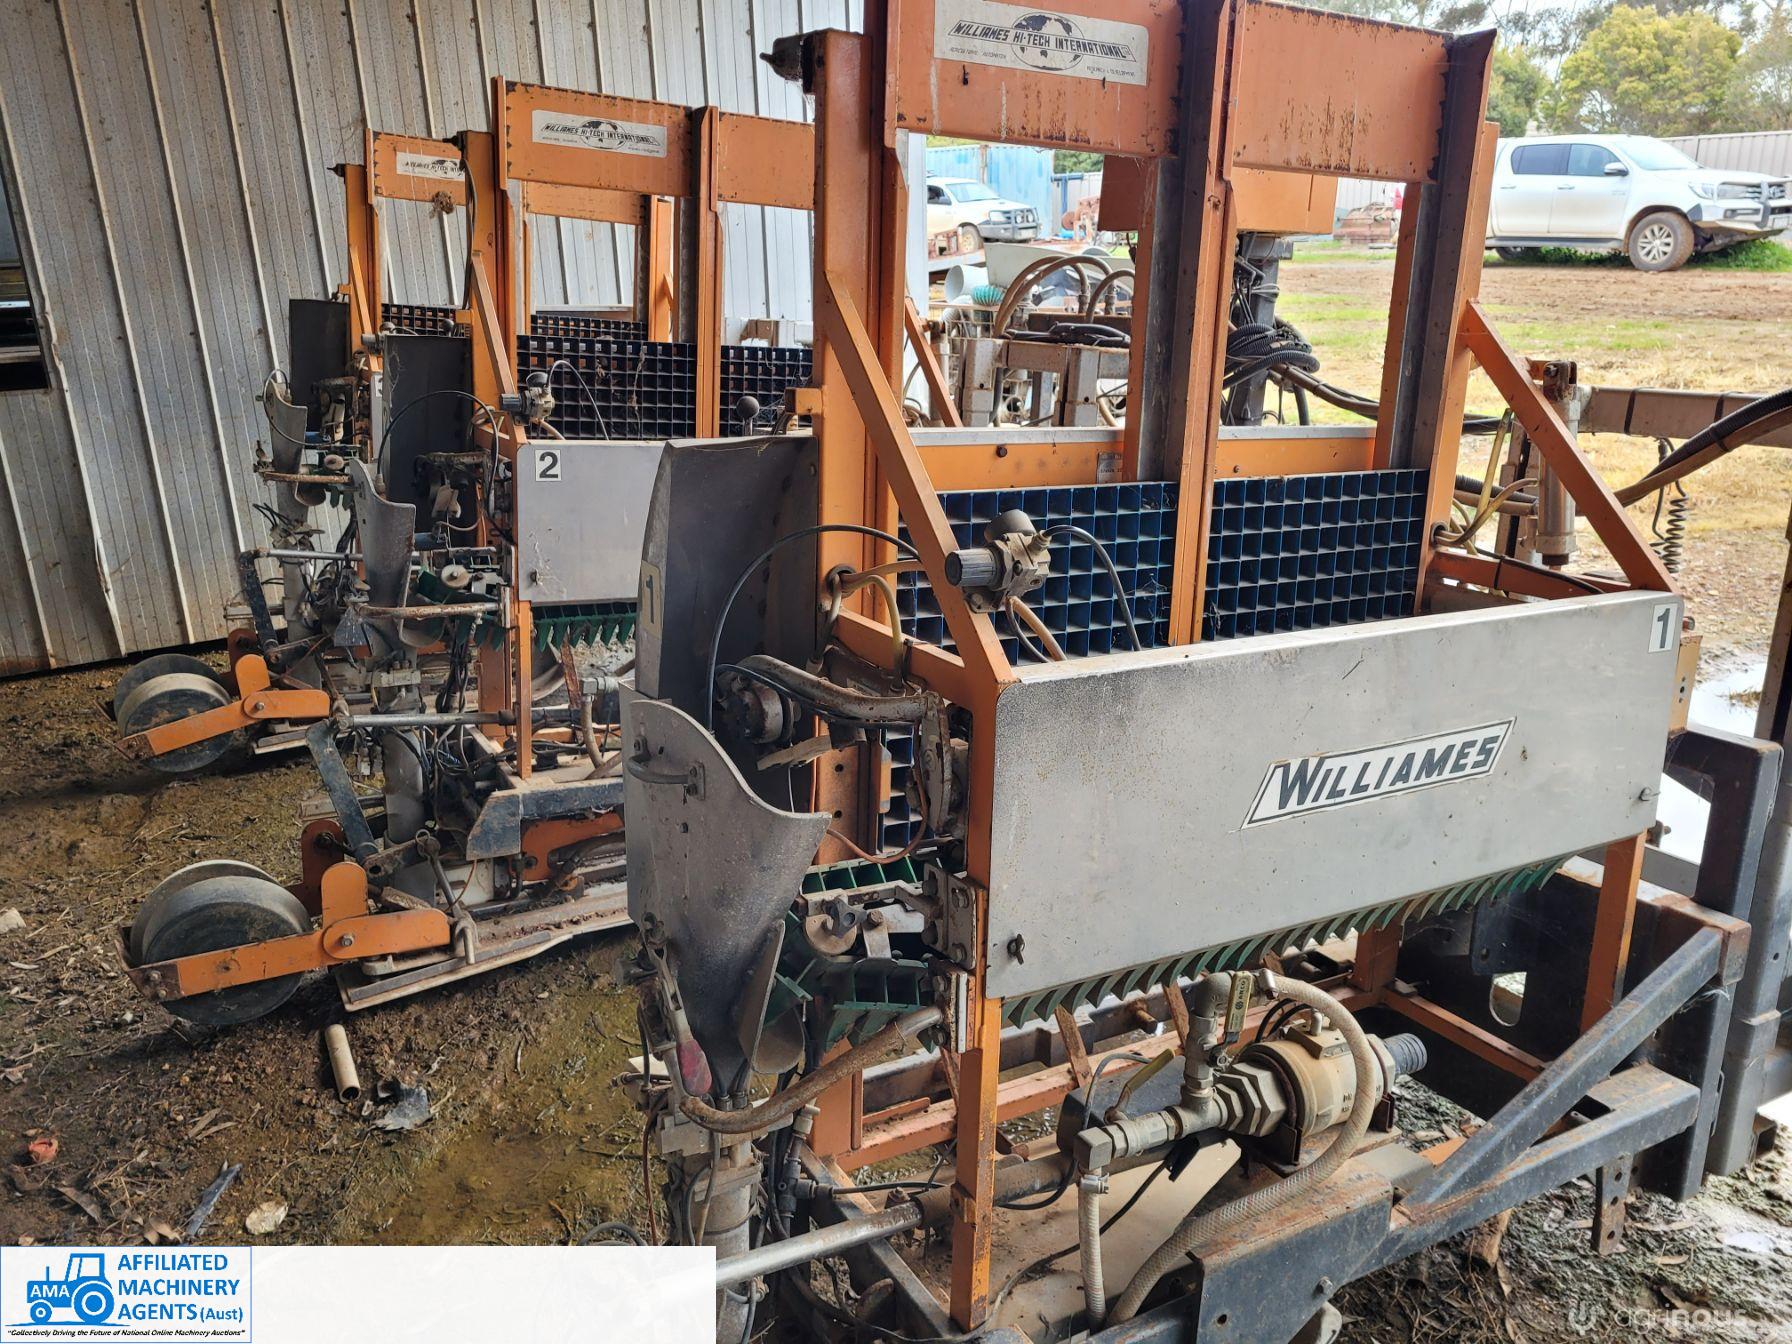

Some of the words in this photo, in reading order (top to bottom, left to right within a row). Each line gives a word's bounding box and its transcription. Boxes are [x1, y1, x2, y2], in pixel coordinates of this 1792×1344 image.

[953, 22, 1010, 41] WILLIAMES
[1055, 36, 1127, 58] INTERNATIONAL
[539, 451, 559, 479] 2
[646, 574, 655, 625] 1
[1657, 607, 1671, 649] 1
[1277, 734, 1501, 810] WILLIAMES
